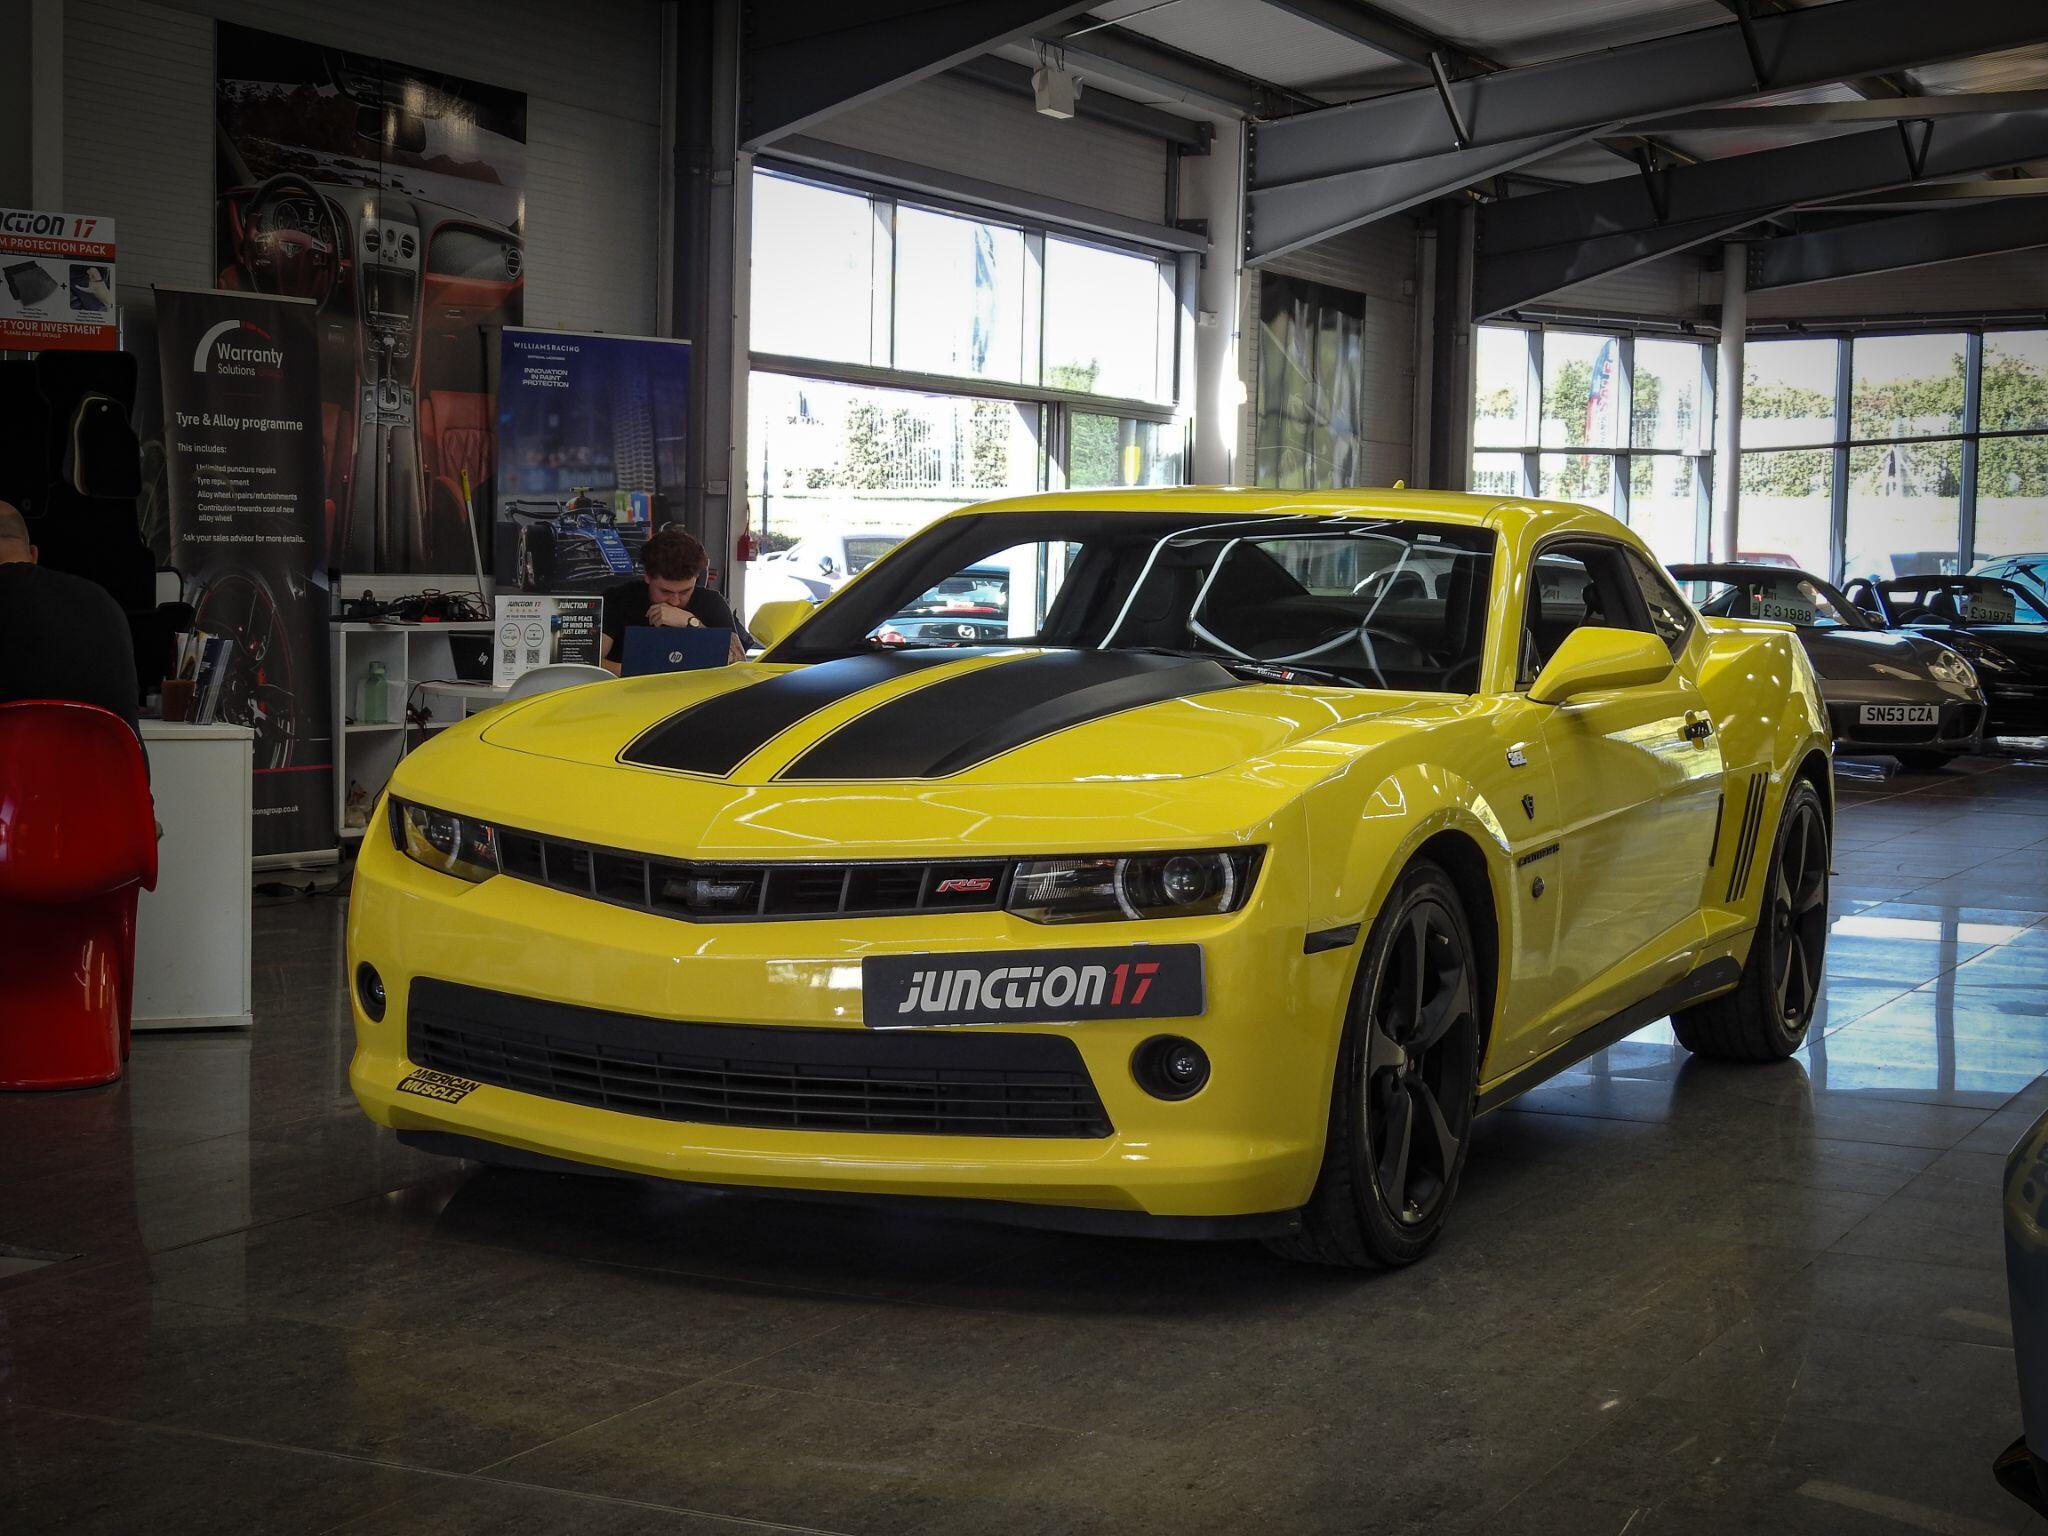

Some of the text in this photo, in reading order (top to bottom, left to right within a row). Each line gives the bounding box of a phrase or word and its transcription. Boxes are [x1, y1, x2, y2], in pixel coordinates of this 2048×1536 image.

[74, 218, 97, 238] 17
[11, 238, 77, 253] PROTECTION
[79, 244, 107, 255] PACK
[10, 320, 38, 331] YOUR
[41, 323, 102, 335] INVESTMENT
[217, 342, 284, 368] Warranty
[218, 363, 256, 376] Solutions
[524, 367, 568, 375] INNOVATION
[522, 379, 569, 388] PROTECTION
[176, 411, 303, 432] Tyre & Alloy programme
[177, 442, 228, 454] This includes:
[226, 466, 255, 475] puncture
[255, 467, 277, 476] repairs
[197, 477, 211, 487] Tyre
[197, 490, 214, 500] Alloy
[214, 491, 231, 499] wheel
[197, 503, 236, 512] Contribution
[236, 505, 261, 513] towards
[199, 514, 233, 523] alloy wheel
[183, 533, 196, 541] Ask
[196, 534, 212, 543] your
[213, 534, 230, 542] sales
[230, 533, 255, 542] advisor
[255, 534, 265, 542] for
[265, 535, 282, 543] more
[1763, 603, 1812, 621] £31988
[1971, 606, 2012, 621] £31975
[1866, 707, 1933, 722] SN53 CZA
[936, 877, 994, 893] RS
[409, 1068, 482, 1092] AMERICAN
[402, 1079, 464, 1102] MUSCLE
